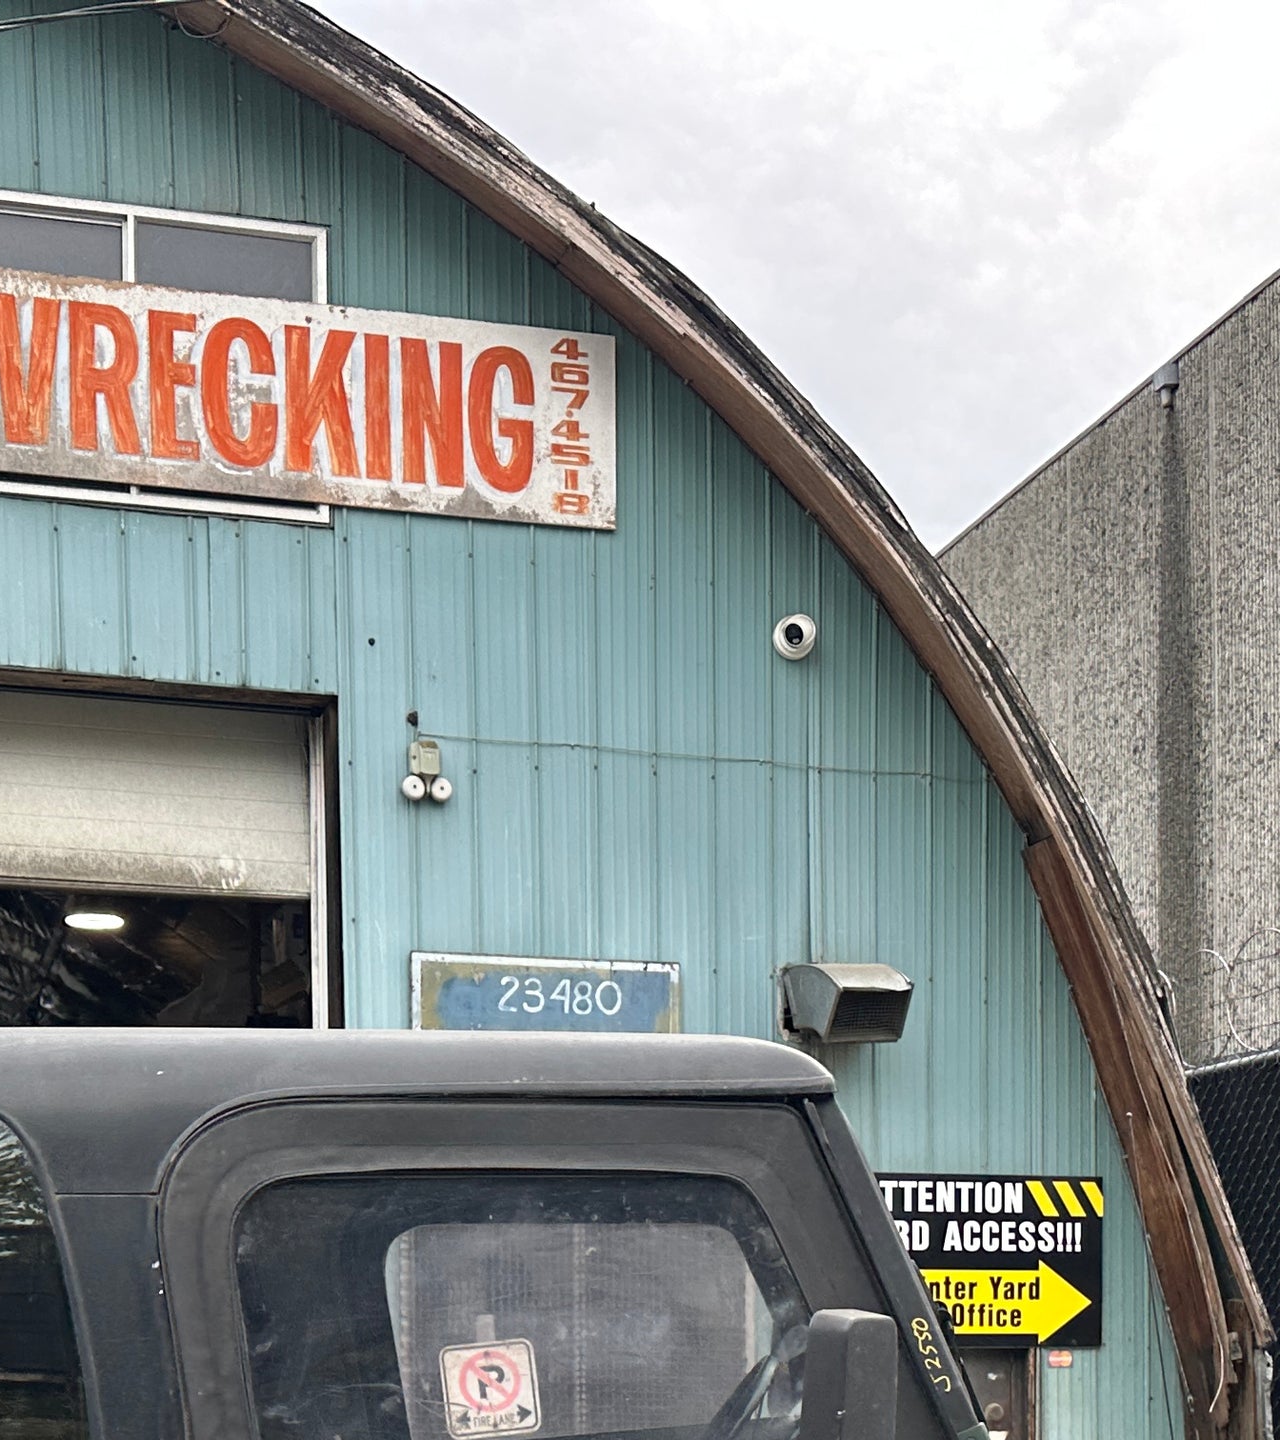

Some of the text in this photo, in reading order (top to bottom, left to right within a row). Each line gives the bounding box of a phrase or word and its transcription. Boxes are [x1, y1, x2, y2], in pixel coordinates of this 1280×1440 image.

[497, 975, 622, 1016] 23480
[879, 1180, 1023, 1213] TTENTION
[893, 1219, 1082, 1253] RD ACCESS!!!
[923, 1276, 1041, 1300] nter Yard
[951, 1303, 1022, 1328] Office
